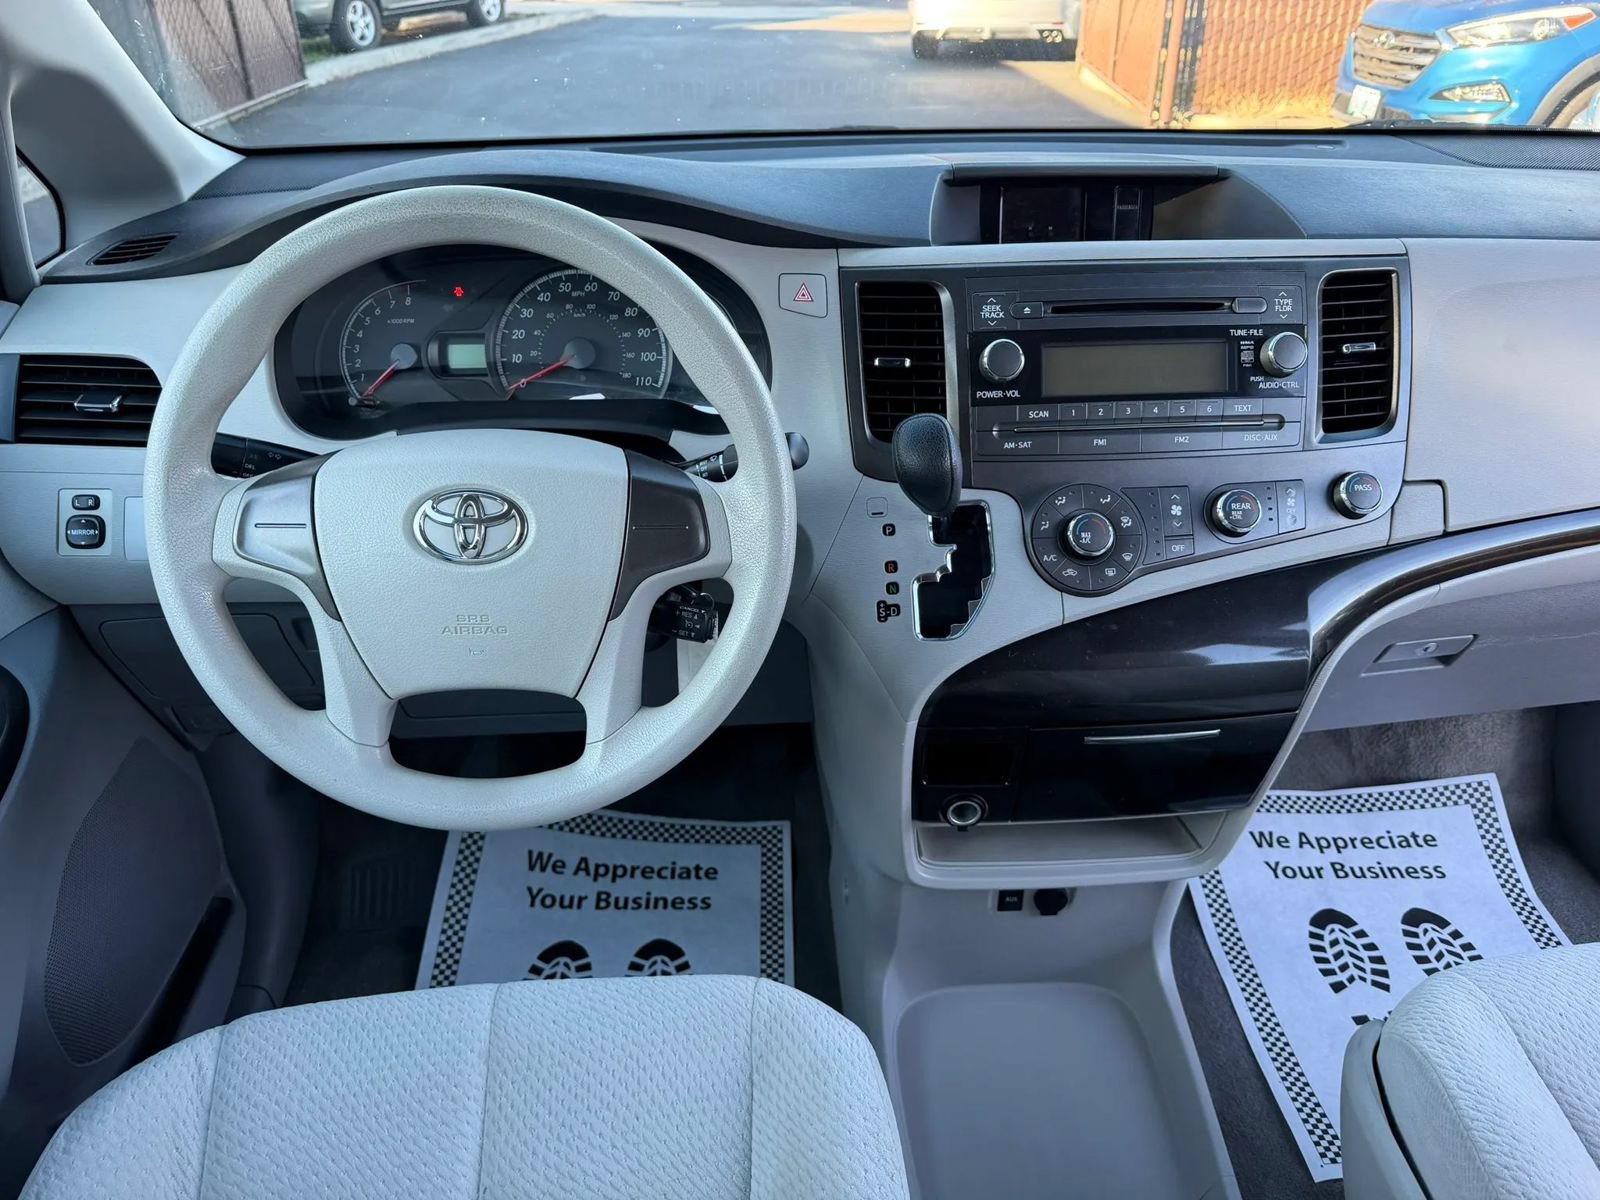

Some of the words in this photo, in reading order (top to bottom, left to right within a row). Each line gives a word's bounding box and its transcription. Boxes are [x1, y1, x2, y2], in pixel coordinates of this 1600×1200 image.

[558, 282, 571, 292] 50
[584, 282, 598, 292] 60
[537, 292, 551, 302] 40
[608, 291, 620, 301] 70
[390, 300, 396, 308] 7
[405, 297, 411, 305] 8
[374, 307, 381, 315] 6
[520, 308, 534, 318] 30
[625, 307, 638, 317] 80
[364, 317, 370, 325] 5
[512, 330, 525, 339] 20
[638, 328, 650, 337] 90
[512, 354, 522, 363] 10
[640, 352, 657, 361] 100
[355, 359, 361, 367] 2
[361, 373, 365, 382] 1
[636, 377, 652, 386] 110
[1028, 410, 1049, 418] SCAN
[886, 526, 892, 535] P
[888, 563, 894, 572] R
[889, 584, 897, 593] N
[441, 626, 508, 635] AIRBAG
[1249, 831, 1291, 849] We
[1298, 829, 1438, 854] Appreciate
[528, 849, 567, 875] We
[574, 857, 719, 882] Appreciate
[1264, 861, 1326, 880] Your
[1330, 861, 1446, 880] Business
[526, 886, 588, 910] Your
[595, 890, 712, 911] Business
